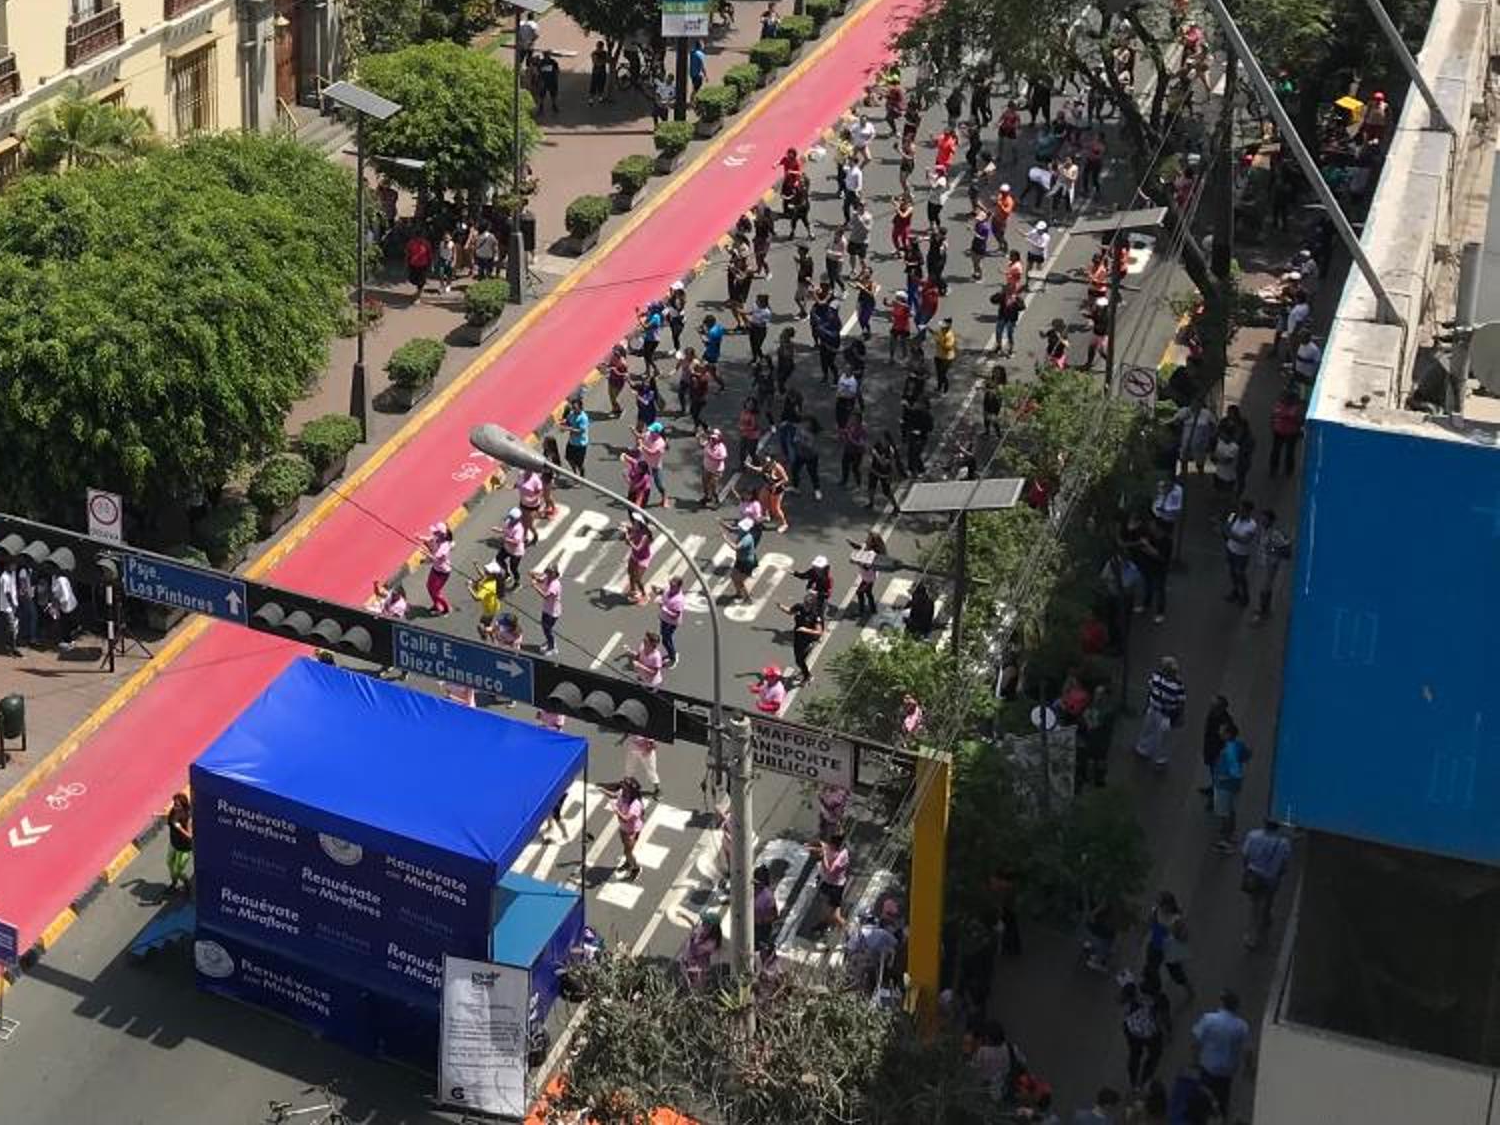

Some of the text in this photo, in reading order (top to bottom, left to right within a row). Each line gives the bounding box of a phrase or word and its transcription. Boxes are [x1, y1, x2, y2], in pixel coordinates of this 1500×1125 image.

[128, 577, 214, 614] Los Pintores
[399, 630, 437, 655] Calle
[435, 660, 504, 692] Canseco
[751, 739, 843, 771] ANSPORTE
[752, 725, 831, 753] MAFORO
[752, 754, 819, 778] UBLICO
[235, 818, 297, 844] Miraflores
[301, 866, 382, 906] Renuévate
[318, 886, 382, 918] Miraflores
[403, 874, 468, 906] Miraflores
[220, 887, 299, 922] Renuévate
[237, 907, 300, 935] Miraflores
[387, 942, 443, 974] Renuév
